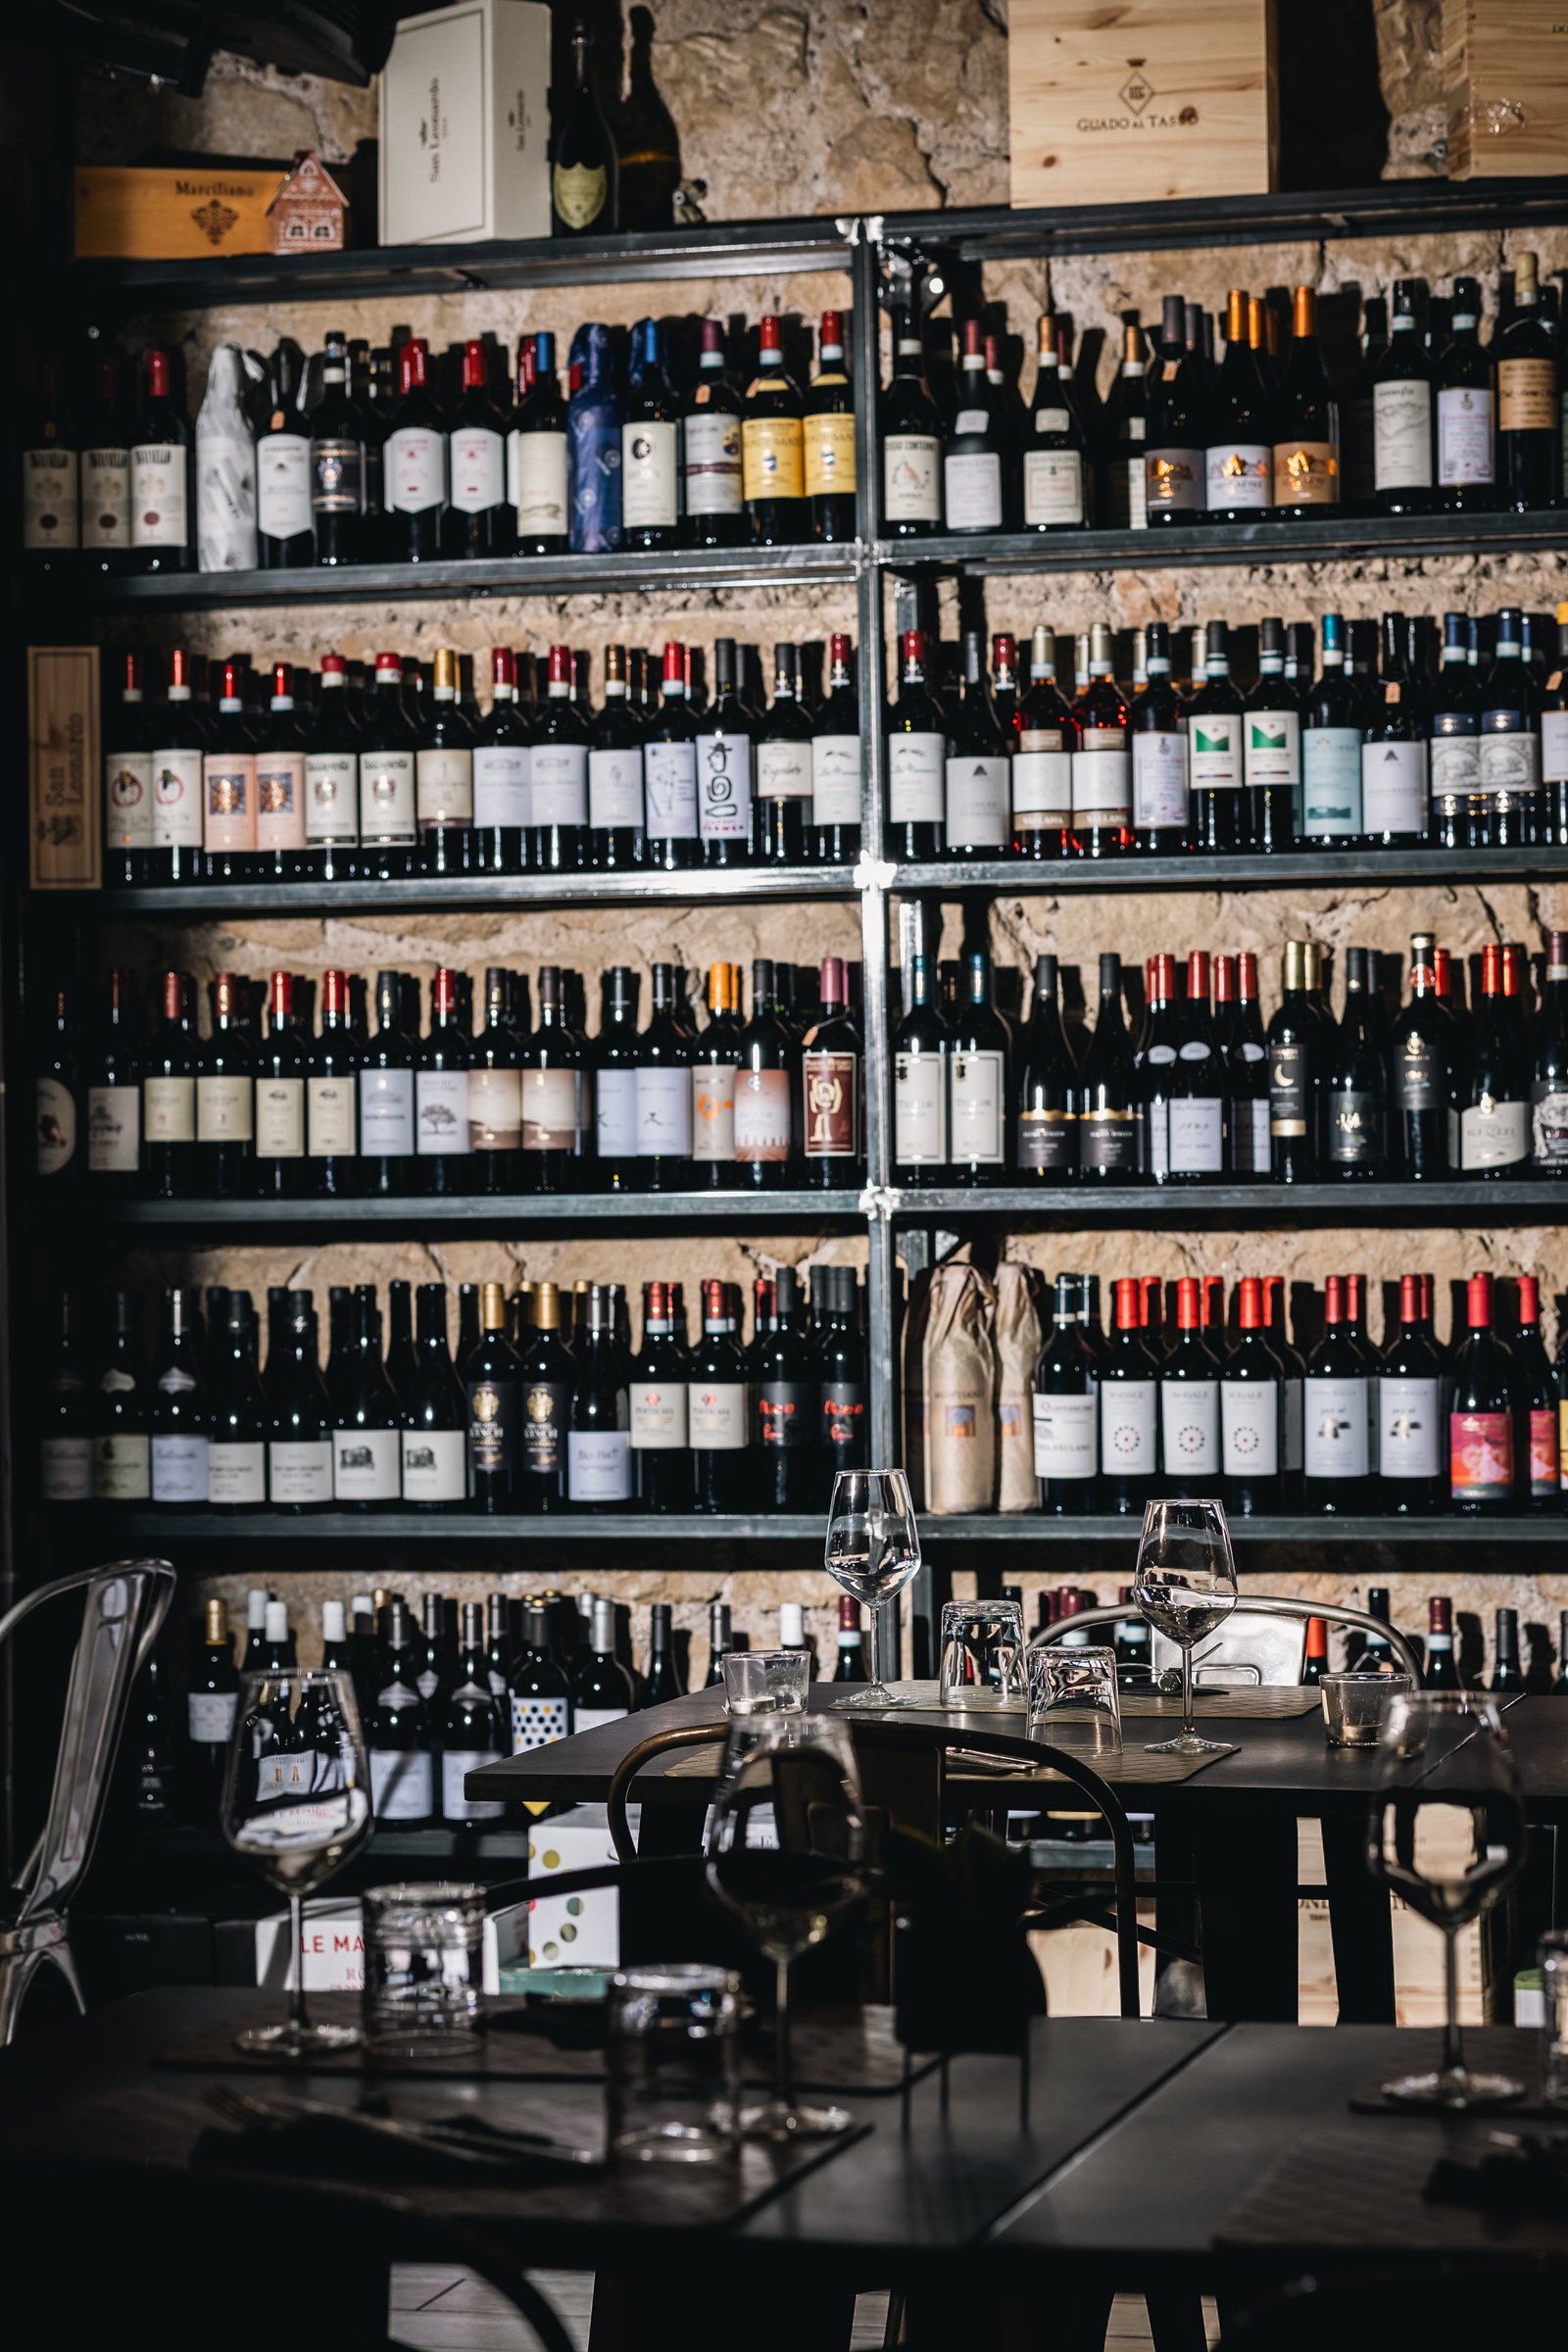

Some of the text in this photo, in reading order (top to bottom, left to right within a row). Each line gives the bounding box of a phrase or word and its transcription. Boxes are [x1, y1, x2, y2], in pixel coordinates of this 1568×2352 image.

[1077, 117, 1130, 131] GUADO
[66, 712, 83, 804] Leonardo
[47, 767, 64, 807] San
[301, 1935, 323, 1954] LE
